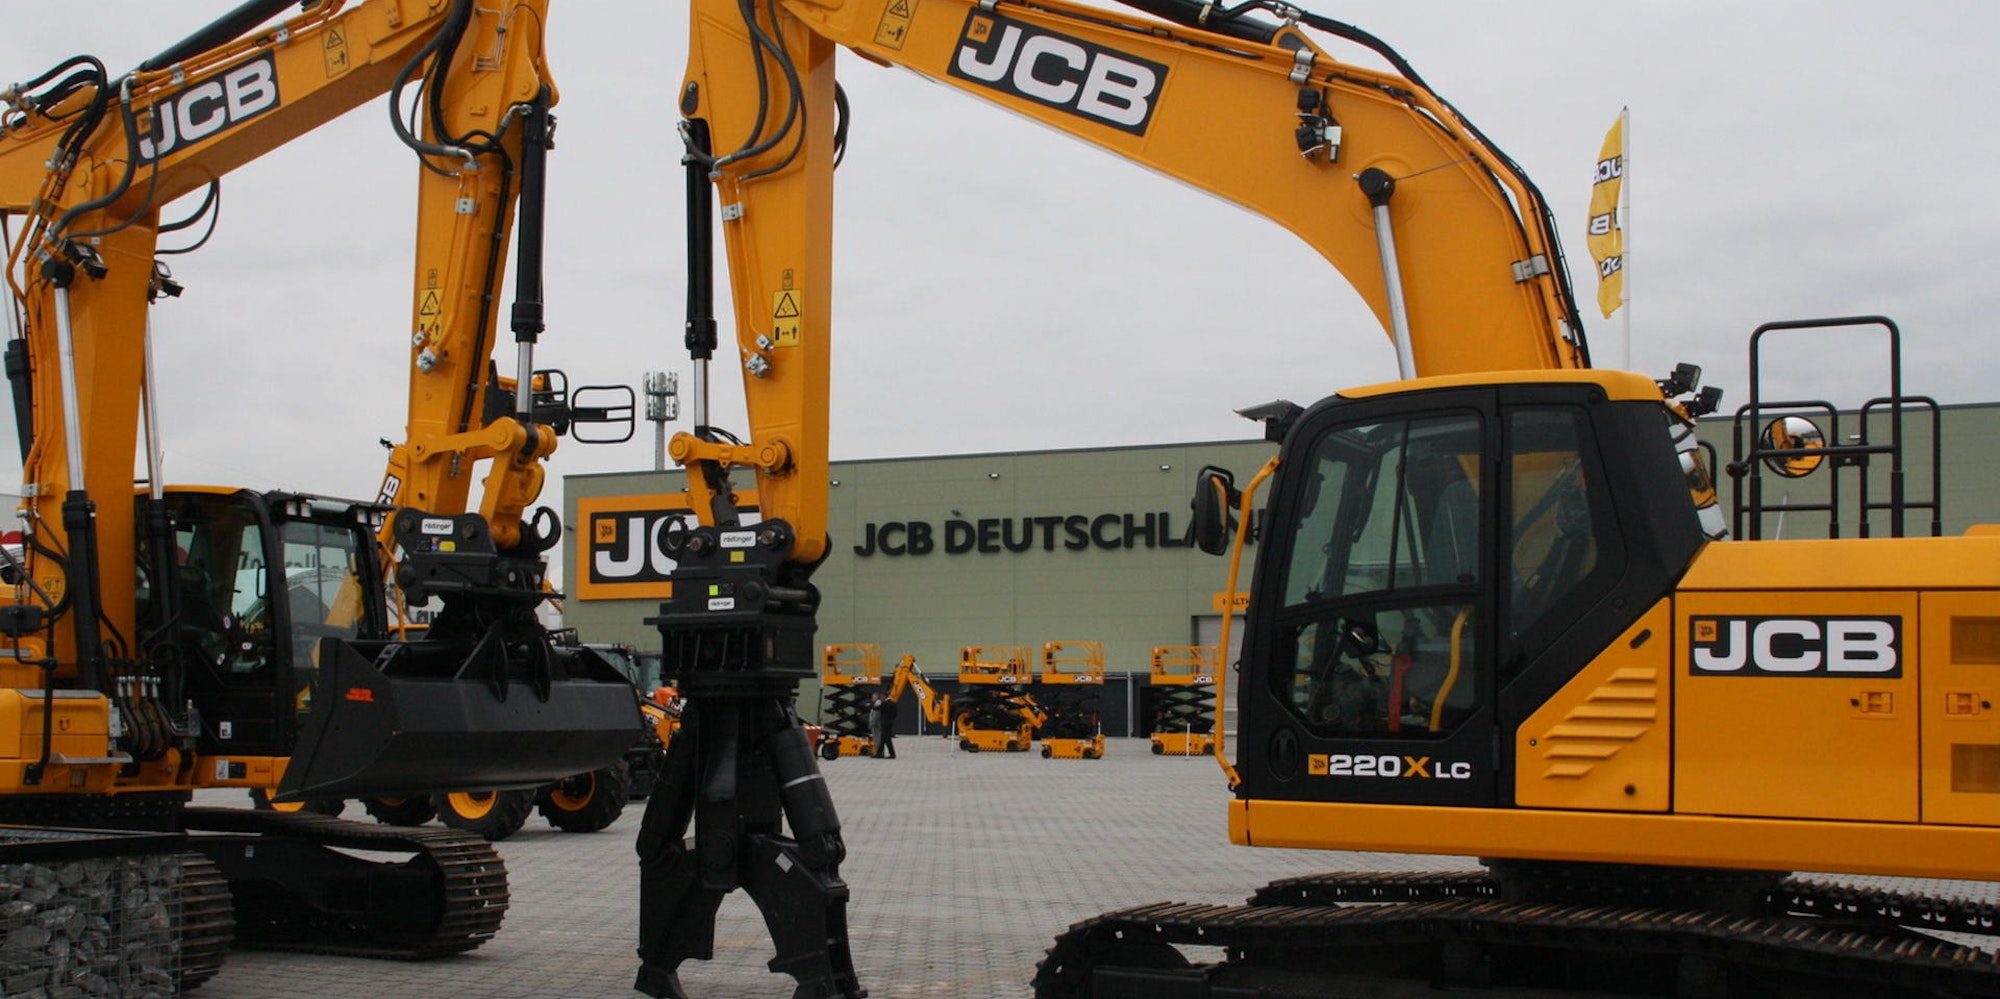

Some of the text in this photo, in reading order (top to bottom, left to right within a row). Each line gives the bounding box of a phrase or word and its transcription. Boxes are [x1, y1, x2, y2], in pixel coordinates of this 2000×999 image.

[958, 25, 1156, 126] JCB
[139, 59, 276, 159] JCB
[853, 521, 934, 557] JCB
[1694, 619, 1896, 672] JCB
[1329, 754, 1431, 778] 220X
[1435, 762, 1471, 778] LC
